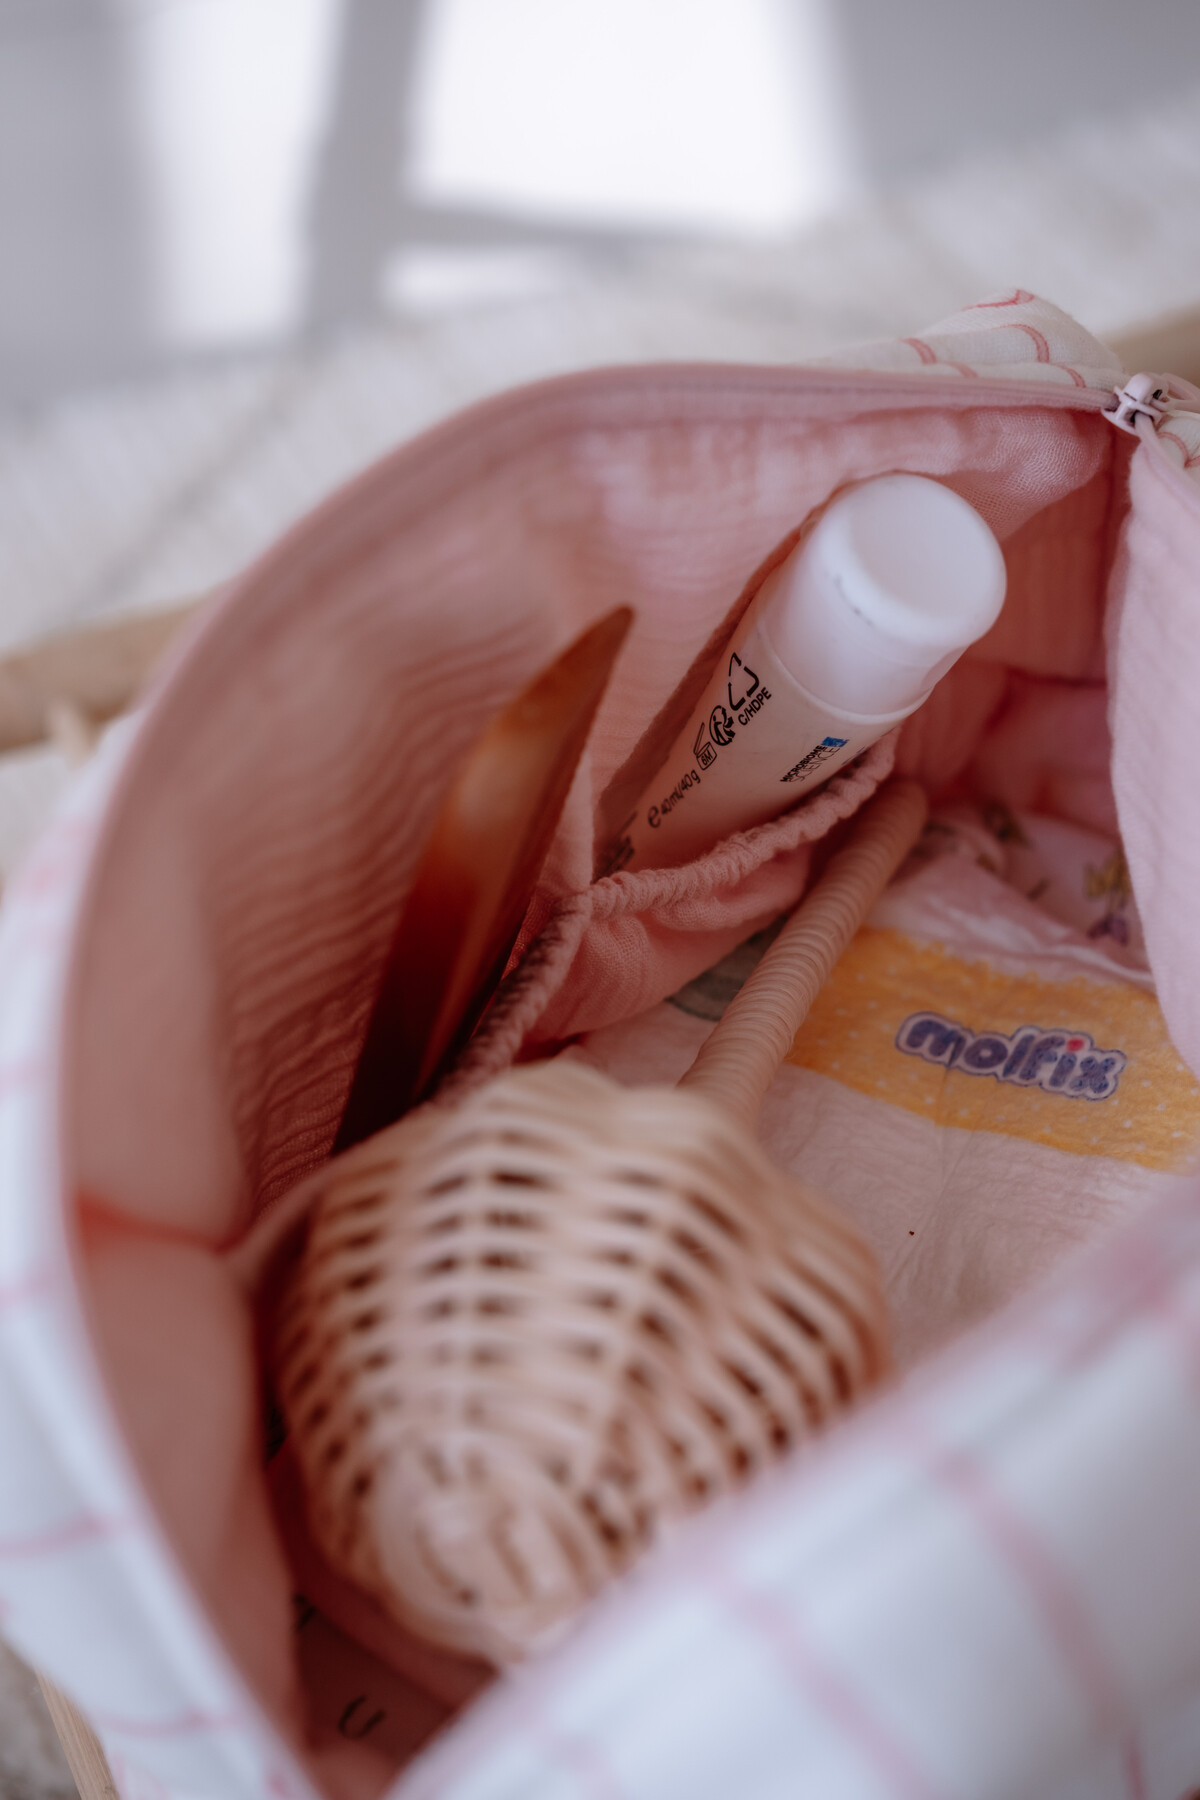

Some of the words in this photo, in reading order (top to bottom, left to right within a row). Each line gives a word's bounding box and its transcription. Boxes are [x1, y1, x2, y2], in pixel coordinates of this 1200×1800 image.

[738, 687, 772, 726] C/HDPE
[701, 749, 713, 766] 6M
[779, 745, 825, 784] MICROBIOME
[788, 747, 840, 782] SCIENCE
[905, 1017, 1118, 1095] molfix
